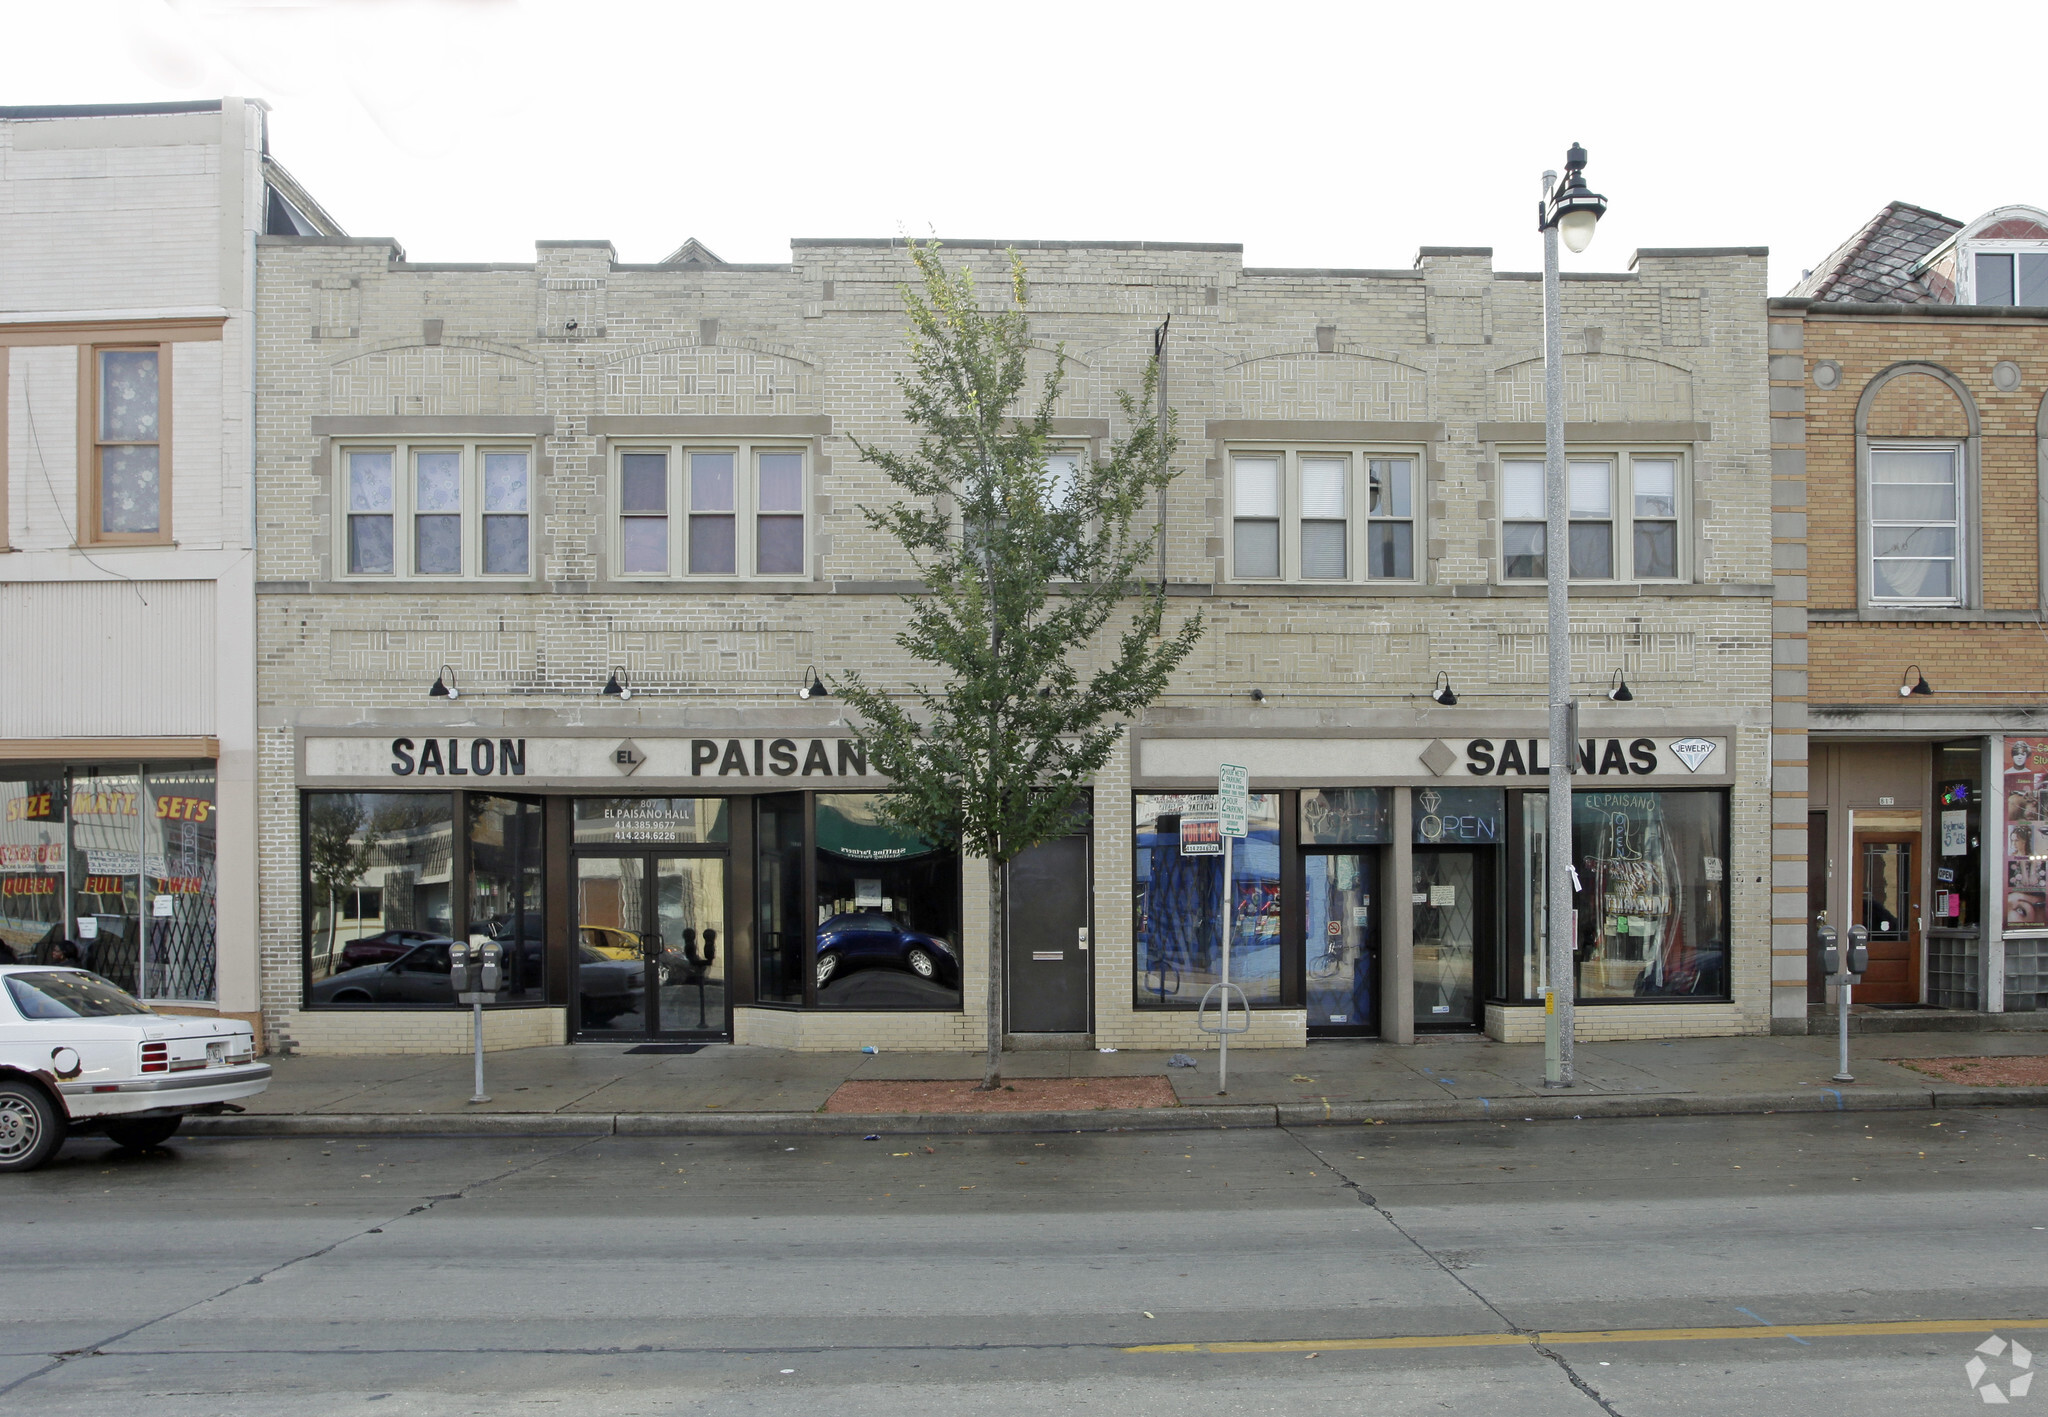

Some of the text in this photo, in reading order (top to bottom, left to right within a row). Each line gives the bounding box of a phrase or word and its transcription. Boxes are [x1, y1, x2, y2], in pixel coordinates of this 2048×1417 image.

[391, 738, 526, 776] SALON
[616, 750, 638, 764] EL
[1466, 738, 1710, 776] SALNAS JEWELRY
[1221, 768, 1226, 781] 2
[1226, 776, 1242, 784] PARKING
[6, 792, 211, 822] SIZE MATT. SETS
[640, 800, 656, 808] 807
[1221, 797, 1227, 811] 2
[1227, 797, 1238, 805] HOUR
[1226, 805, 1243, 814] PARKING
[1585, 794, 1656, 812] EL PAISANO
[604, 809, 689, 820] EL PAISANO HALL
[615, 821, 676, 829] 414.385.9677
[1183, 824, 1199, 842] FOR
[1420, 815, 1495, 839] OPEN
[615, 832, 676, 840] 414.234.6226
[1615, 814, 1625, 858] OPEN
[183, 825, 196, 877] OPEN
[1938, 869, 1953, 880] OPEN
[2, 877, 202, 897] QUEEN FULL TWIN
